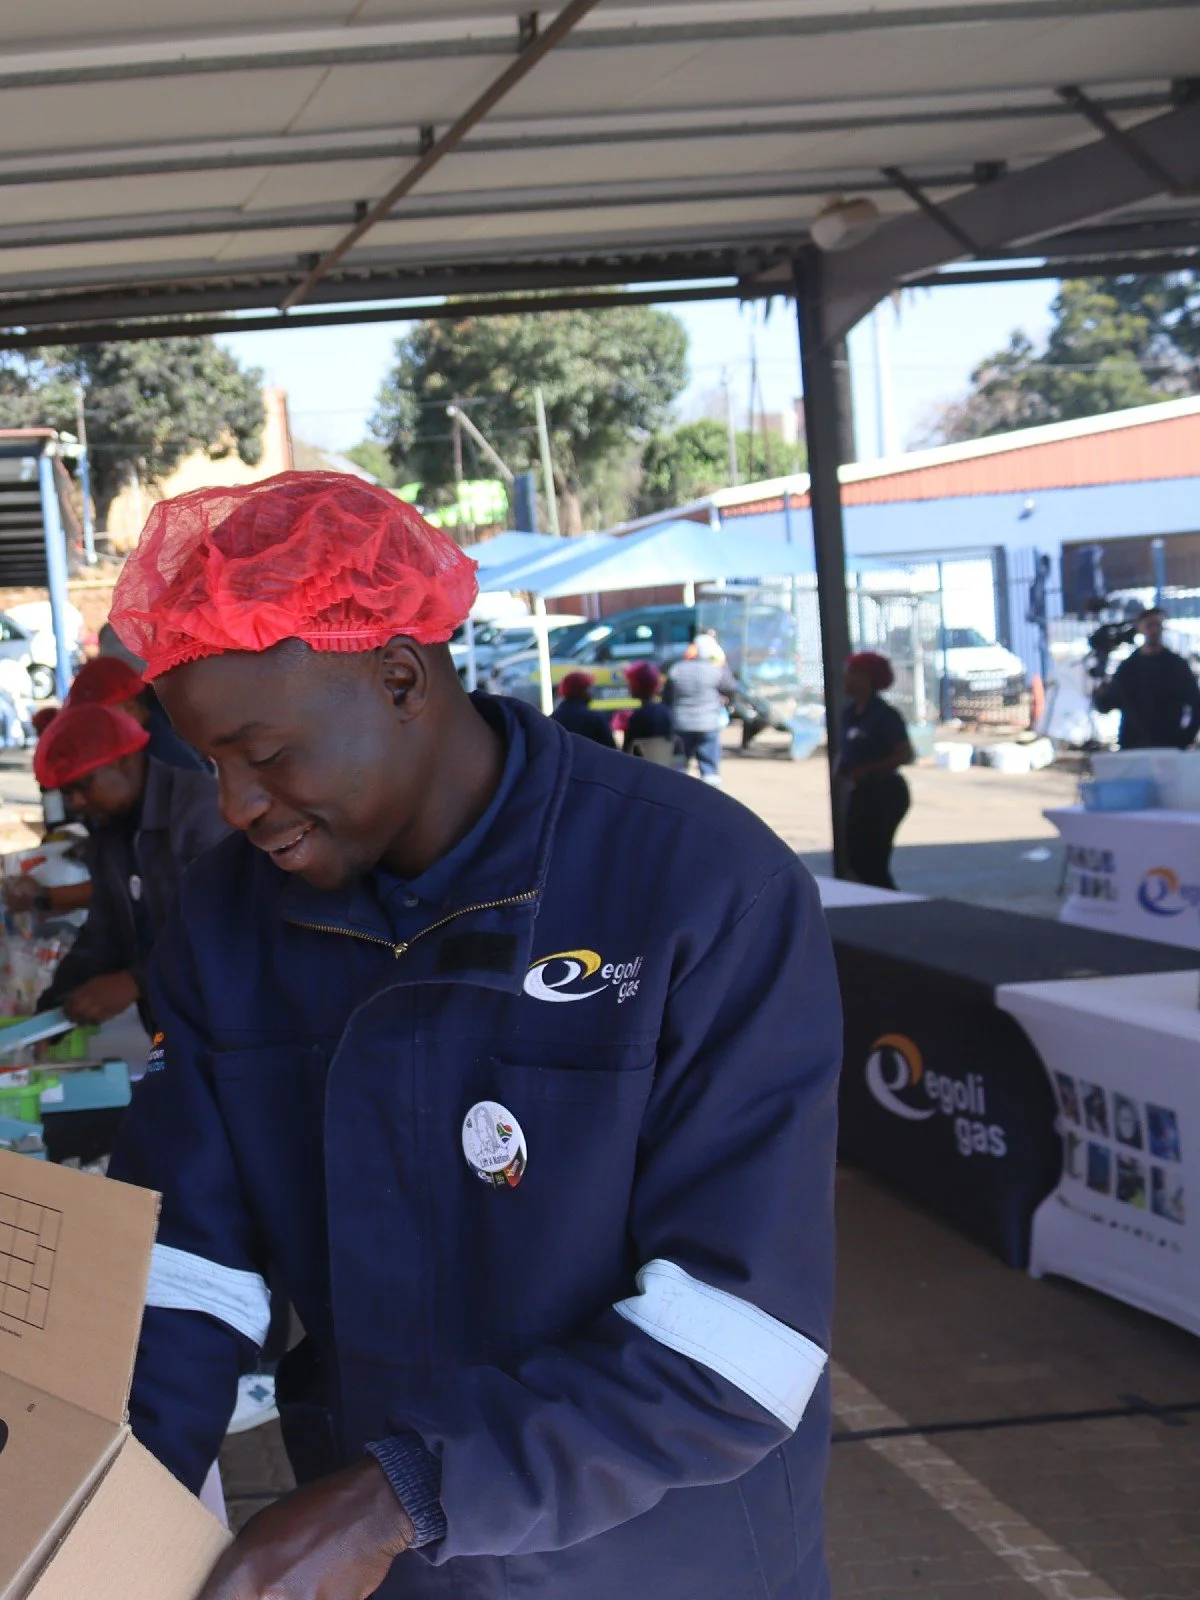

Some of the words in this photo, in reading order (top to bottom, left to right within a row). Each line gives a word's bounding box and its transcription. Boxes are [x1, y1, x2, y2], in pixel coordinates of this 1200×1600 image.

[601, 956, 644, 985] egoli
[617, 979, 641, 1003] gas
[924, 1070, 986, 1116] egoli
[954, 1116, 1007, 1158] gas
